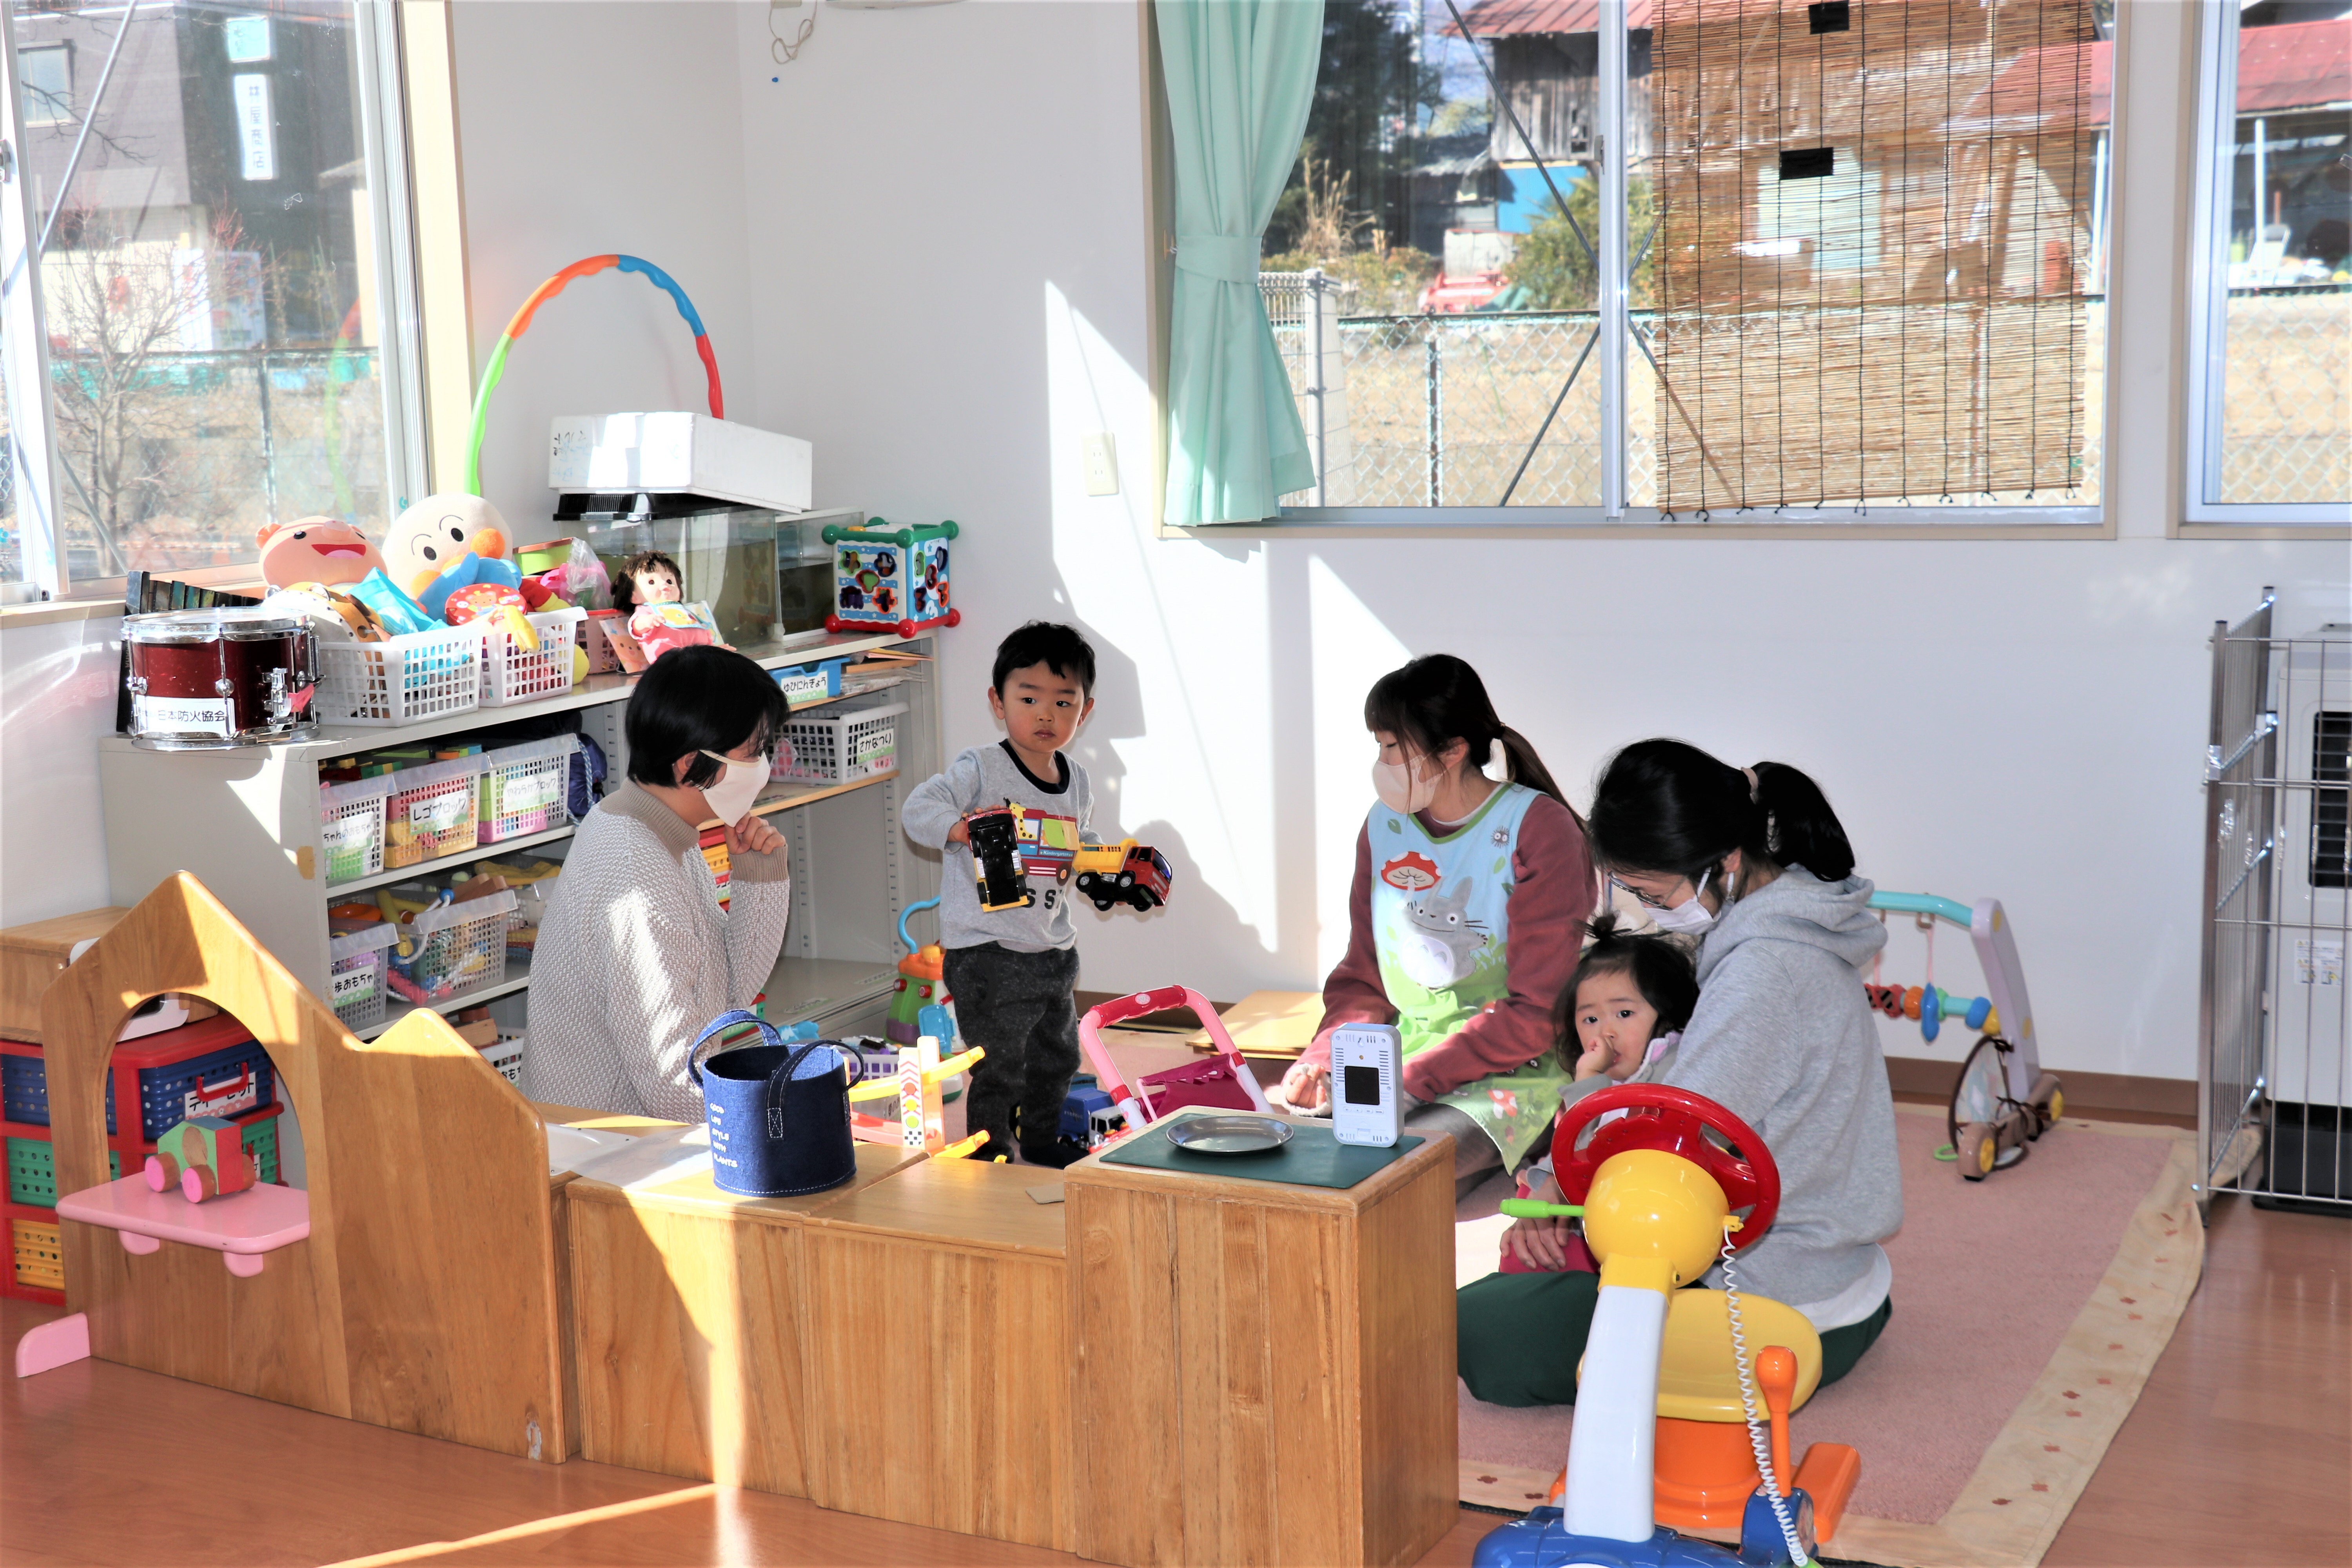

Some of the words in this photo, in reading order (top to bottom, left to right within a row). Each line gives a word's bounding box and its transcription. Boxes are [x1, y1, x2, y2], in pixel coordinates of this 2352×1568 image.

[784, 677, 826, 692] ゆびにんぎょう
[859, 733, 891, 752] さかなつり
[507, 778, 556, 797] やわらかブロック
[414, 798, 466, 821] レゴブロック
[333, 974, 373, 993] 歩おもちゃ
[712, 1128, 730, 1141] STYLE
[713, 1140, 726, 1153] WITH
[714, 1152, 738, 1168] PLANTS
